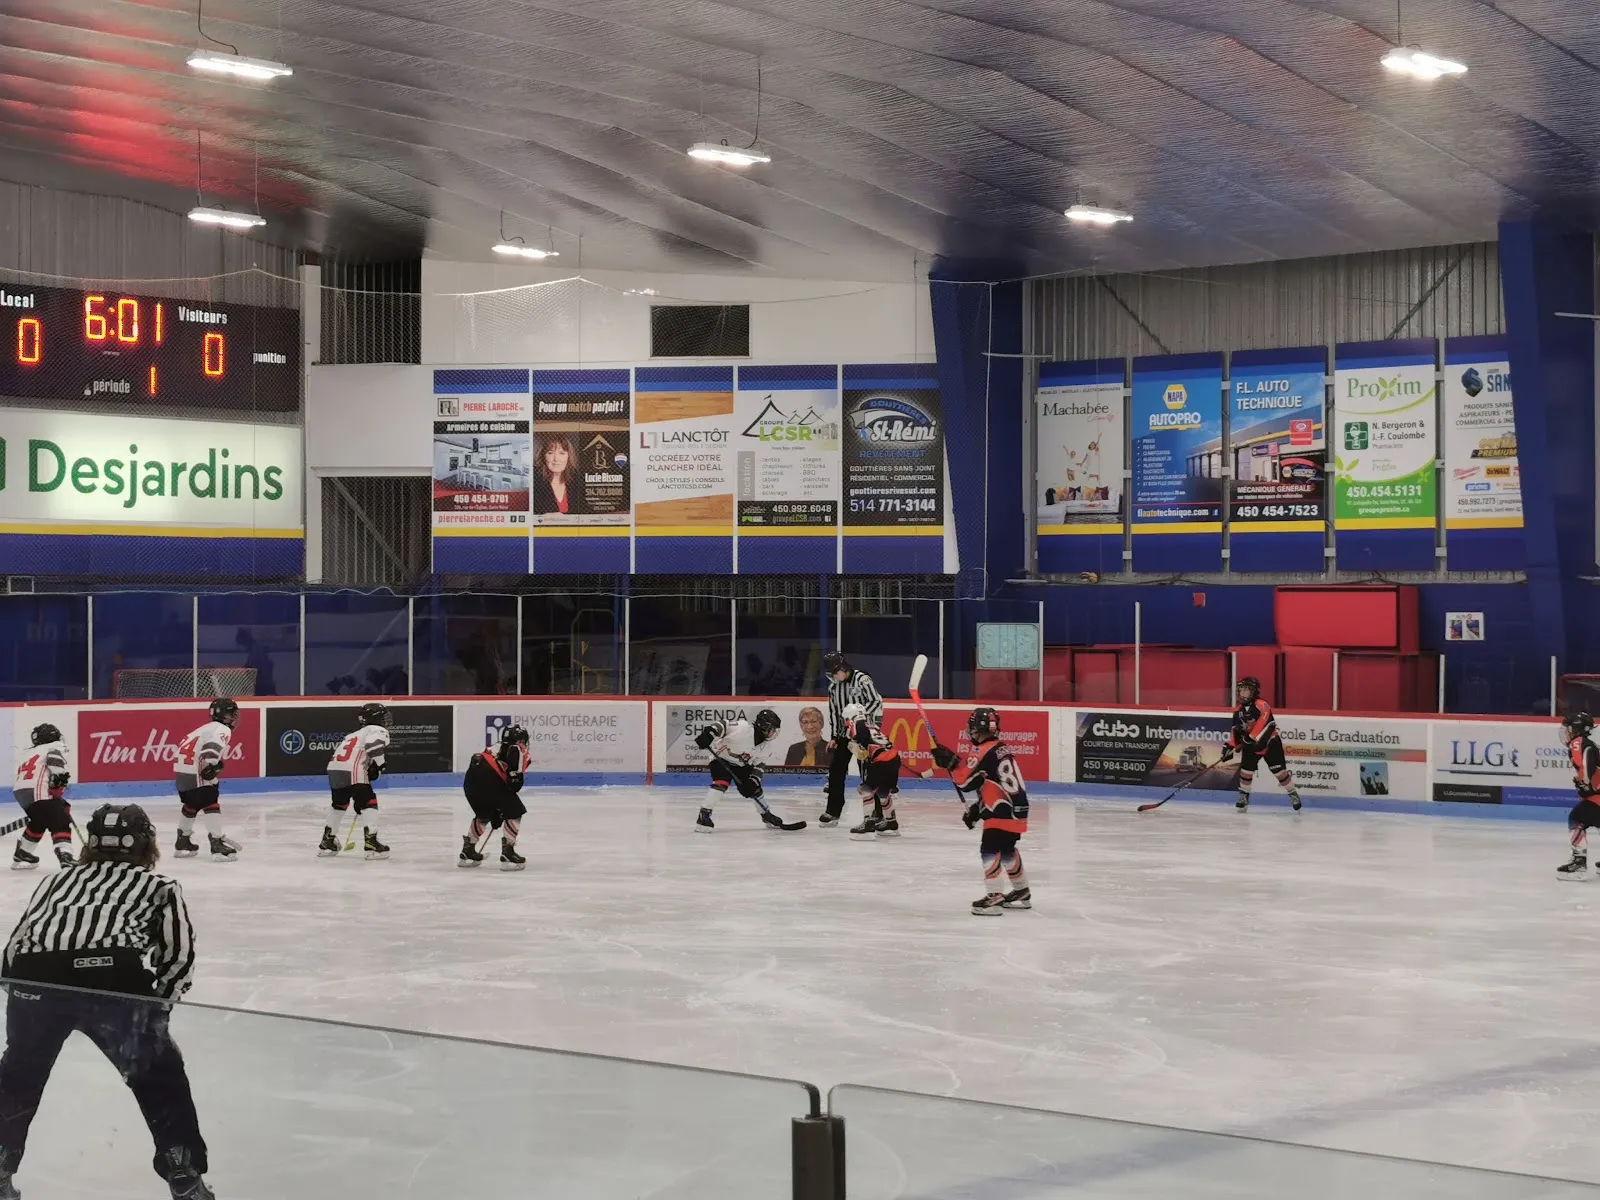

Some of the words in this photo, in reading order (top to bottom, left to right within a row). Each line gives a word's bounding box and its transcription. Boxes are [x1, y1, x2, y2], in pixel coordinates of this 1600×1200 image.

[1, 290, 34, 308] Local
[85, 296, 162, 342] 6:01
[178, 305, 228, 324] Visiteurs
[19, 319, 39, 362] 0
[204, 333, 224, 375] 0
[253, 352, 287, 364] punition
[93, 379, 131, 394] période
[150, 367, 156, 394] 1
[1236, 382, 1253, 394] F.L.
[1256, 380, 1289, 393] AUTO
[1168, 391, 1184, 402] NAPA
[463, 402, 486, 411] PIERRE
[488, 402, 518, 411] LAROCHE
[538, 401, 556, 412] Pour
[557, 402, 567, 412] un
[568, 401, 591, 412] match
[592, 400, 617, 413] parfait
[1042, 402, 1109, 416] Machabée
[1236, 396, 1302, 410] TECHNIQUE
[1464, 402, 1494, 410] PRODUITS
[1149, 412, 1202, 426] AUTOPRO
[1459, 410, 1500, 418] ASPIRATEURS
[447, 423, 478, 431] Armoires
[480, 423, 488, 431] de
[490, 422, 515, 431] cuisine
[871, 420, 936, 440] St-Rémi
[1372, 422, 1380, 430] N.
[1382, 421, 1416, 430] Bergeron
[1418, 420, 1424, 428] &
[662, 428, 730, 442] LANCTÔT
[759, 426, 813, 442] LCSR
[1388, 432, 1426, 440] Coulombe
[648, 453, 690, 462] COCRÉEZ
[692, 454, 722, 462] VOTRE
[28, 439, 284, 508] Desjardins
[647, 464, 694, 472] PLANCHER
[850, 464, 892, 472] GOUTTIÈRES
[585, 473, 601, 482] Lucie
[602, 472, 623, 482] Bisson
[744, 457, 752, 496] location
[850, 486, 936, 496] gouttieresrivesud.com
[1236, 486, 1276, 494] MÉCANIQUE
[1276, 484, 1311, 492] GÉNÉRALE
[1346, 484, 1422, 498] 450.454.5131
[454, 495, 469, 503] 450
[772, 504, 832, 512] 450.992.6048
[850, 500, 876, 512] 514
[879, 499, 936, 512] 771-3144
[1236, 506, 1258, 516] 450
[1262, 504, 1318, 516] 454-7523
[1358, 506, 1410, 514] groupeproxim.ca
[438, 515, 505, 523] pierrelaroche.ca
[1138, 508, 1208, 518] flautotechnique.com
[514, 713, 618, 728] PHYSIOTHÉRAPIE
[685, 709, 748, 722] BRENDA
[1092, 719, 1140, 738] dubo
[570, 731, 617, 742] Leclerc
[1310, 728, 1324, 741] La
[1328, 730, 1400, 744] Graduation
[89, 730, 136, 764] Tim
[958, 742, 968, 753] les
[1082, 740, 1114, 748] COURTIER
[1125, 742, 1160, 750] TRANSPORT
[1285, 746, 1311, 754] Centre
[1312, 747, 1322, 755] de
[1324, 748, 1353, 756] soutien
[1355, 748, 1386, 758] scolaire
[1451, 740, 1504, 767] LLG
[1083, 760, 1100, 769] 450
[1103, 762, 1146, 772] 984-8400
[75, 957, 113, 967] CCM
[13, 990, 42, 1000] CCM
